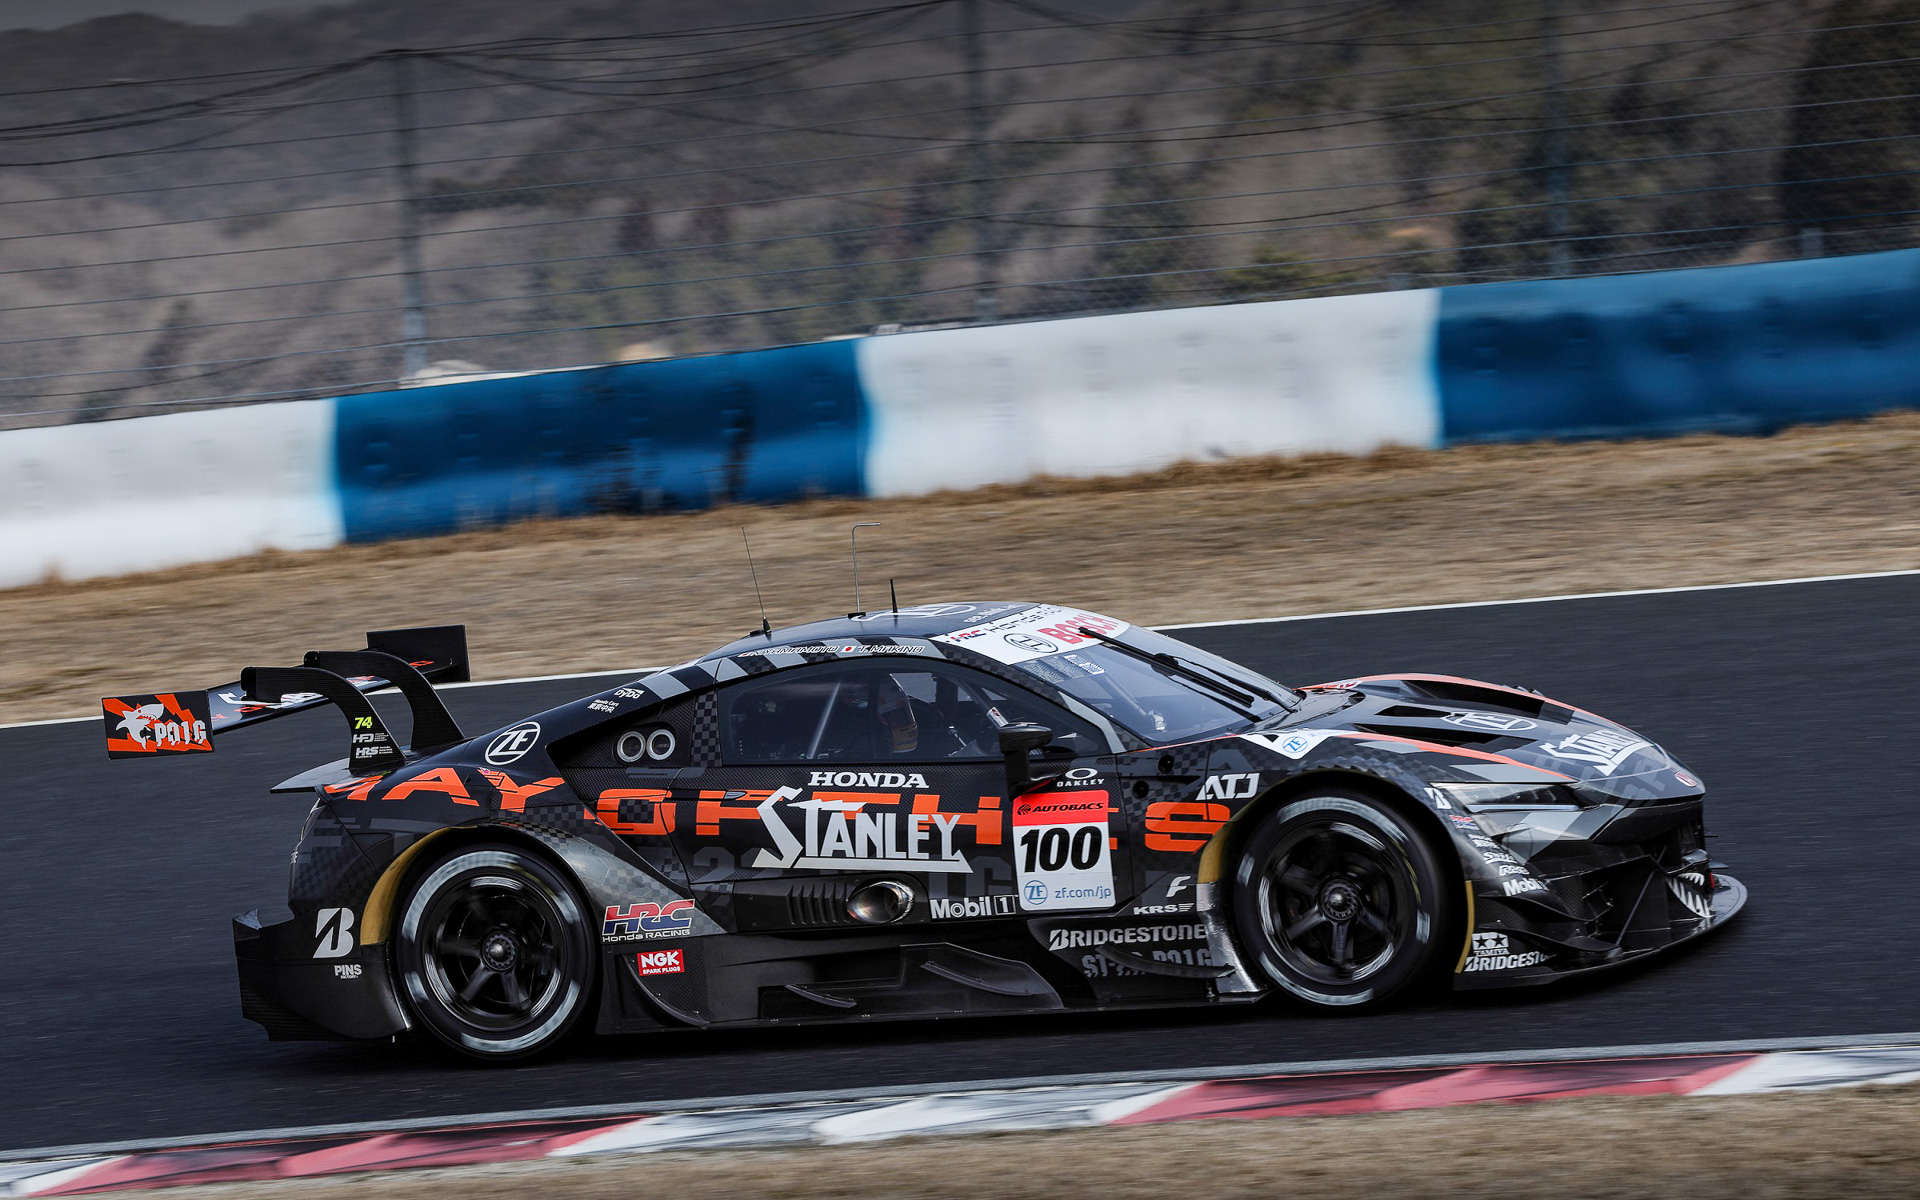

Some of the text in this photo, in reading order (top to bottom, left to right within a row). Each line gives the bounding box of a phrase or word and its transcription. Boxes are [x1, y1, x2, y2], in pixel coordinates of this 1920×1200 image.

[614, 688, 643, 699] DyDo
[355, 716, 373, 729] 74
[487, 725, 539, 760] ZF
[1282, 736, 1308, 753] ZF
[355, 747, 379, 756] HRS
[807, 771, 929, 789] HONDA
[1056, 778, 1104, 787] OAKLEY
[1031, 802, 1104, 813] AUTOBACS
[751, 785, 974, 873] STANLEY
[1020, 826, 1103, 873] 100
[1024, 882, 1048, 903] ZF
[1054, 886, 1111, 899] zf.com/jp
[930, 896, 992, 919] Mobil
[1134, 904, 1180, 915] KRS
[602, 899, 695, 936] HRC
[602, 928, 690, 942] Honda RACING
[1049, 924, 1207, 950] BRIDGESTONE
[640, 950, 680, 968] NGK
[1473, 948, 1510, 957] TAMIYA
[334, 964, 362, 976] PINS
